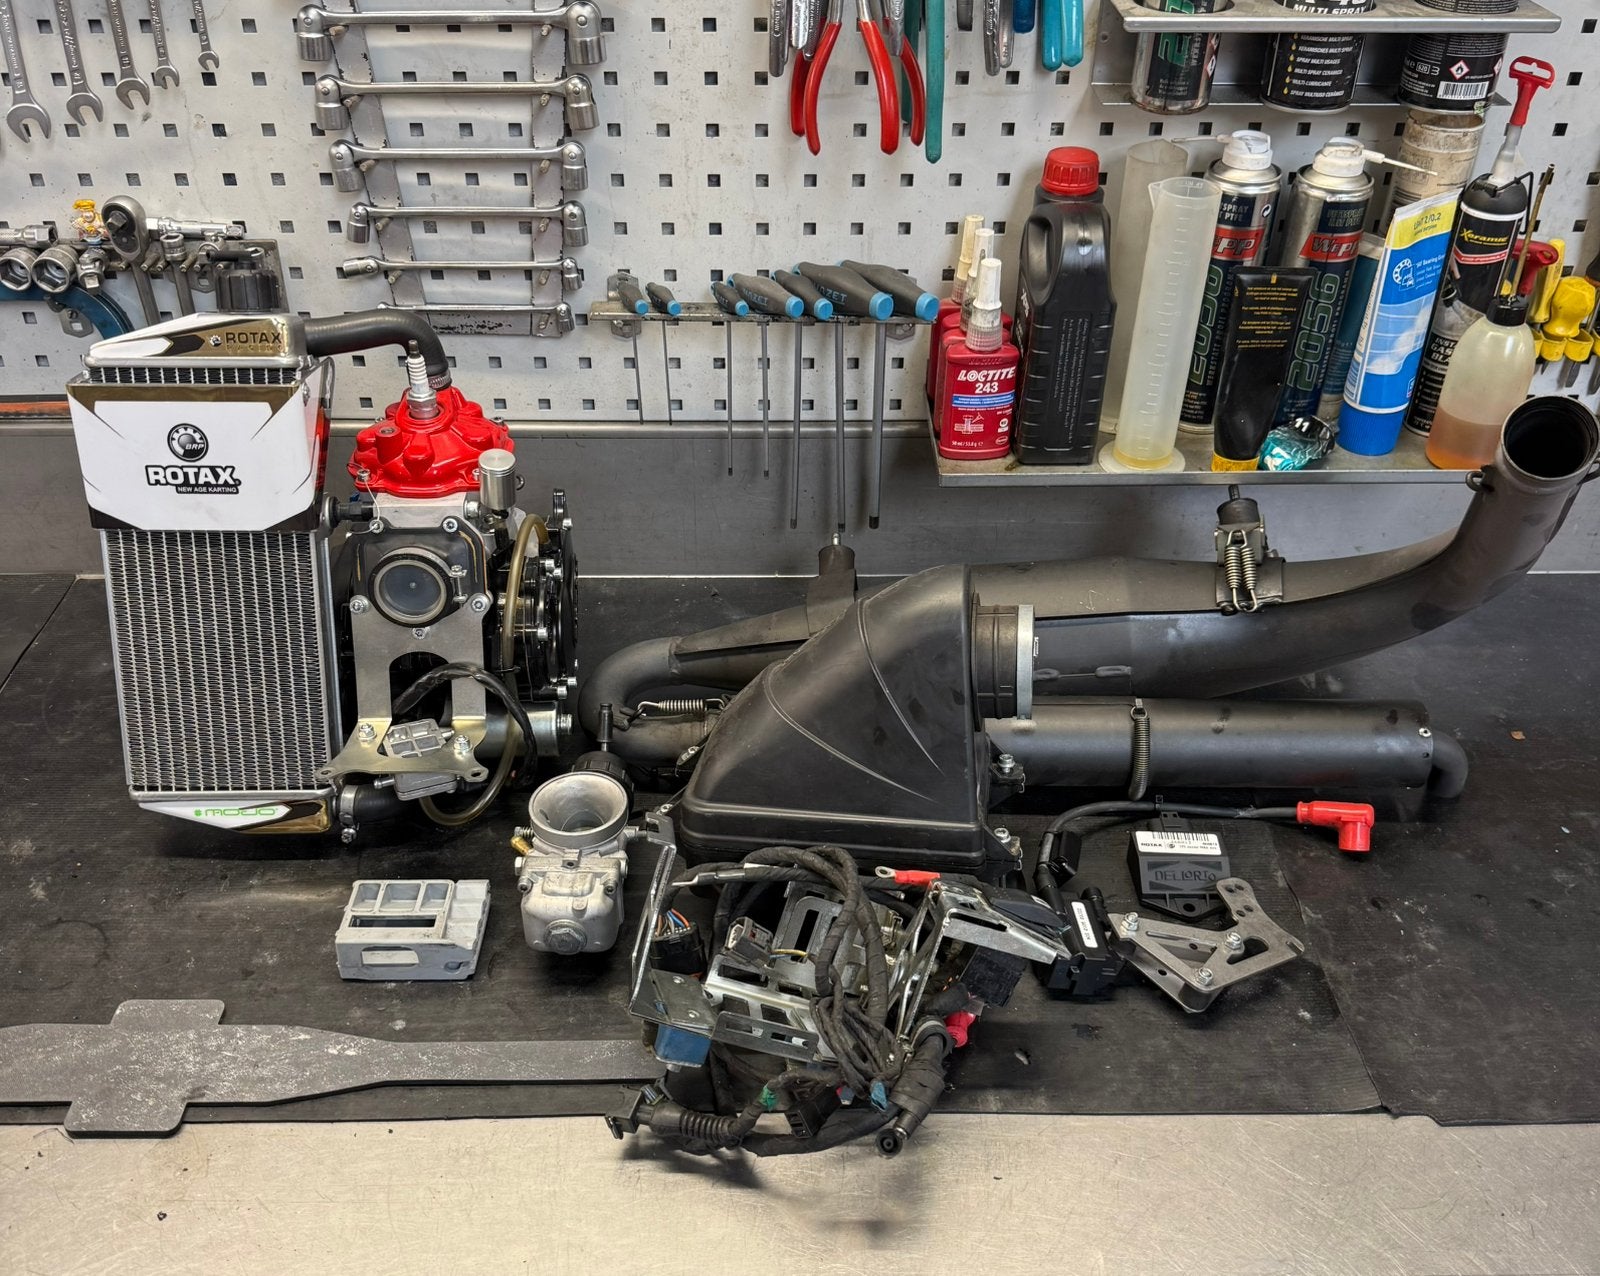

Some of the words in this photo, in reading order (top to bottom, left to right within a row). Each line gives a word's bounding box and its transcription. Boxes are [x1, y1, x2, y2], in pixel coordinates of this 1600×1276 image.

[225, 332, 282, 344] ROTAX
[1286, 272, 1340, 392] 2056
[1430, 343, 1454, 355] GAS
[958, 366, 1016, 381] LOCTITE
[975, 382, 998, 394] 243
[147, 467, 236, 484] ROTAX
